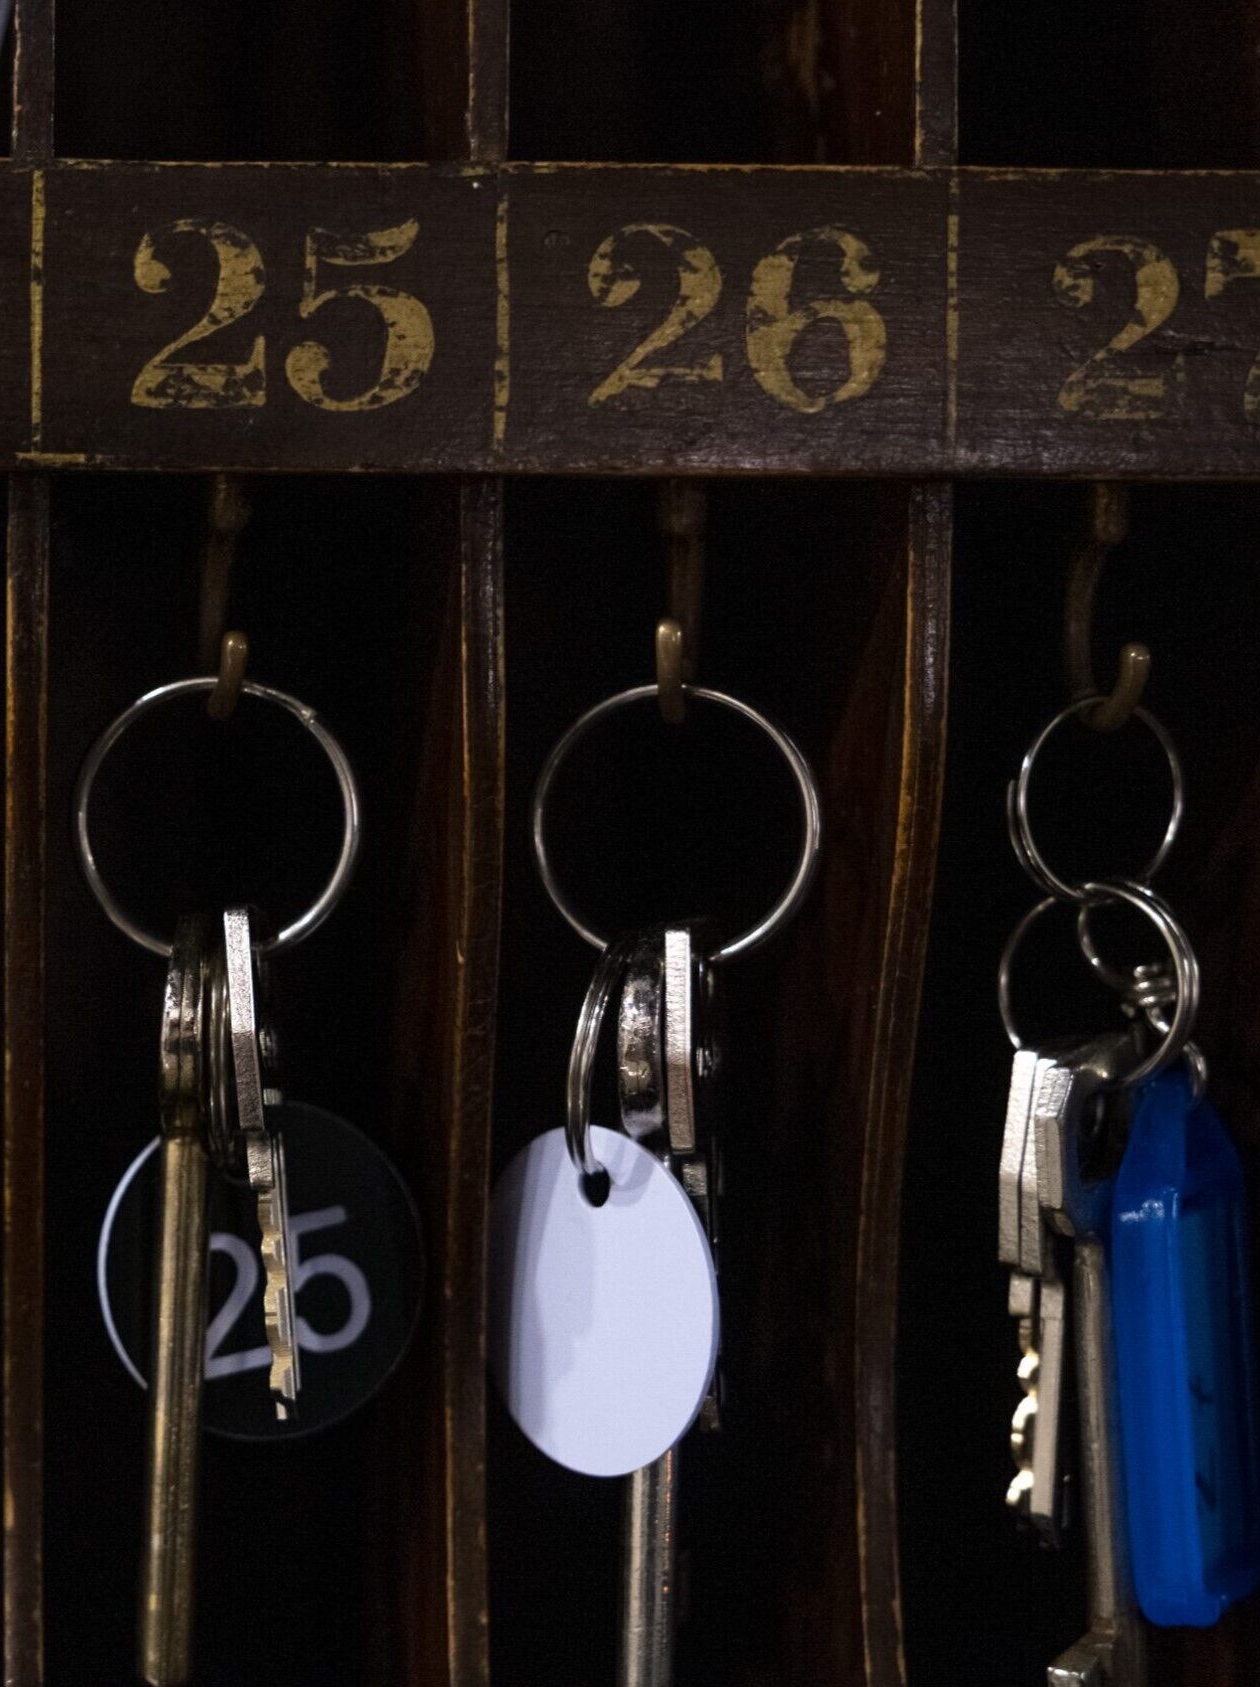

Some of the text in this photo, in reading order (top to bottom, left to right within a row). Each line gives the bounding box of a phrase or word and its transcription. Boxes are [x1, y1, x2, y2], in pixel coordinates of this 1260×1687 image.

[131, 217, 436, 412] 25
[587, 222, 888, 414] 26
[203, 1203, 373, 1381] 25
